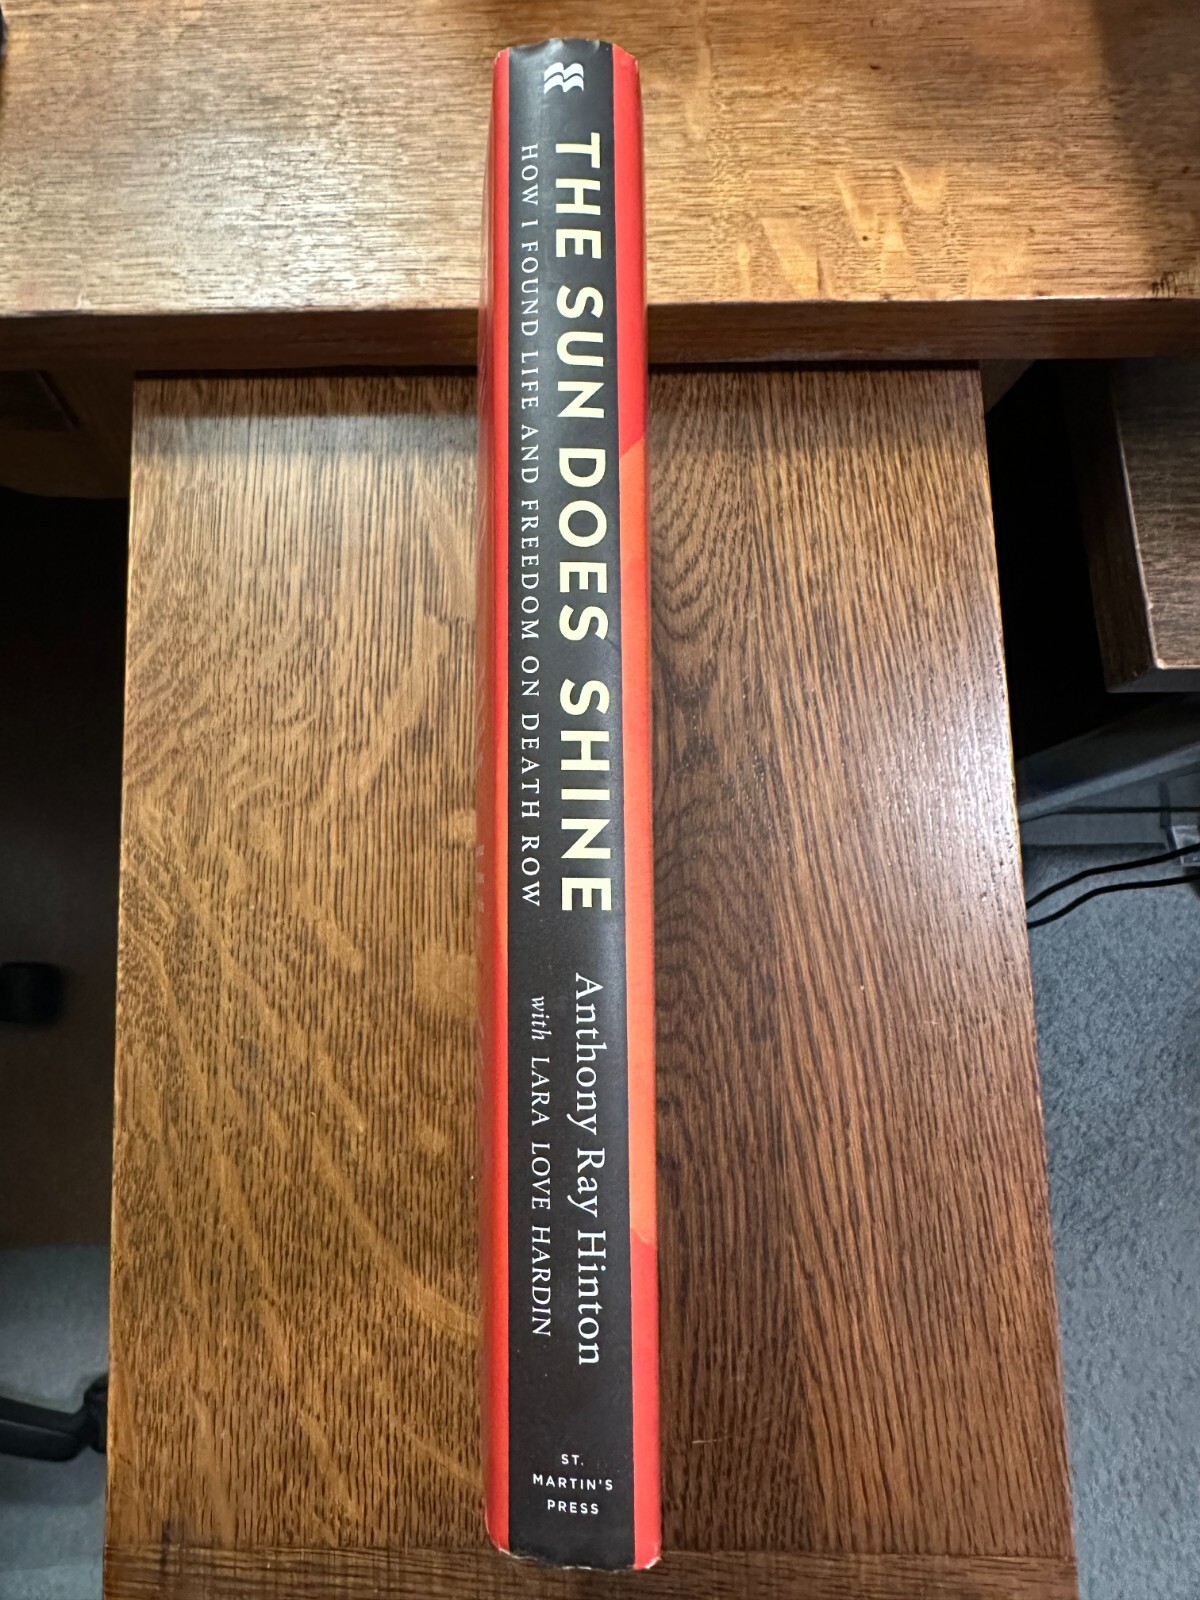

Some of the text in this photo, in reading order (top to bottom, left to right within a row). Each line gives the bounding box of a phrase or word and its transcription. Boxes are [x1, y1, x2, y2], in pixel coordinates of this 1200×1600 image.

[521, 142, 541, 907] HOW I FOUND LIFE AND FREEDOM ON DEATH ROW
[555, 131, 613, 913] THE SUN DOES SHINE
[531, 995, 553, 1337] with LARA LOVE HARDIN
[566, 972, 608, 1365] Anthony Ray Hinton
[533, 1474, 612, 1491] MARTIN'S
[547, 1499, 598, 1514] PRESS
[561, 1454, 584, 1466] ST.
